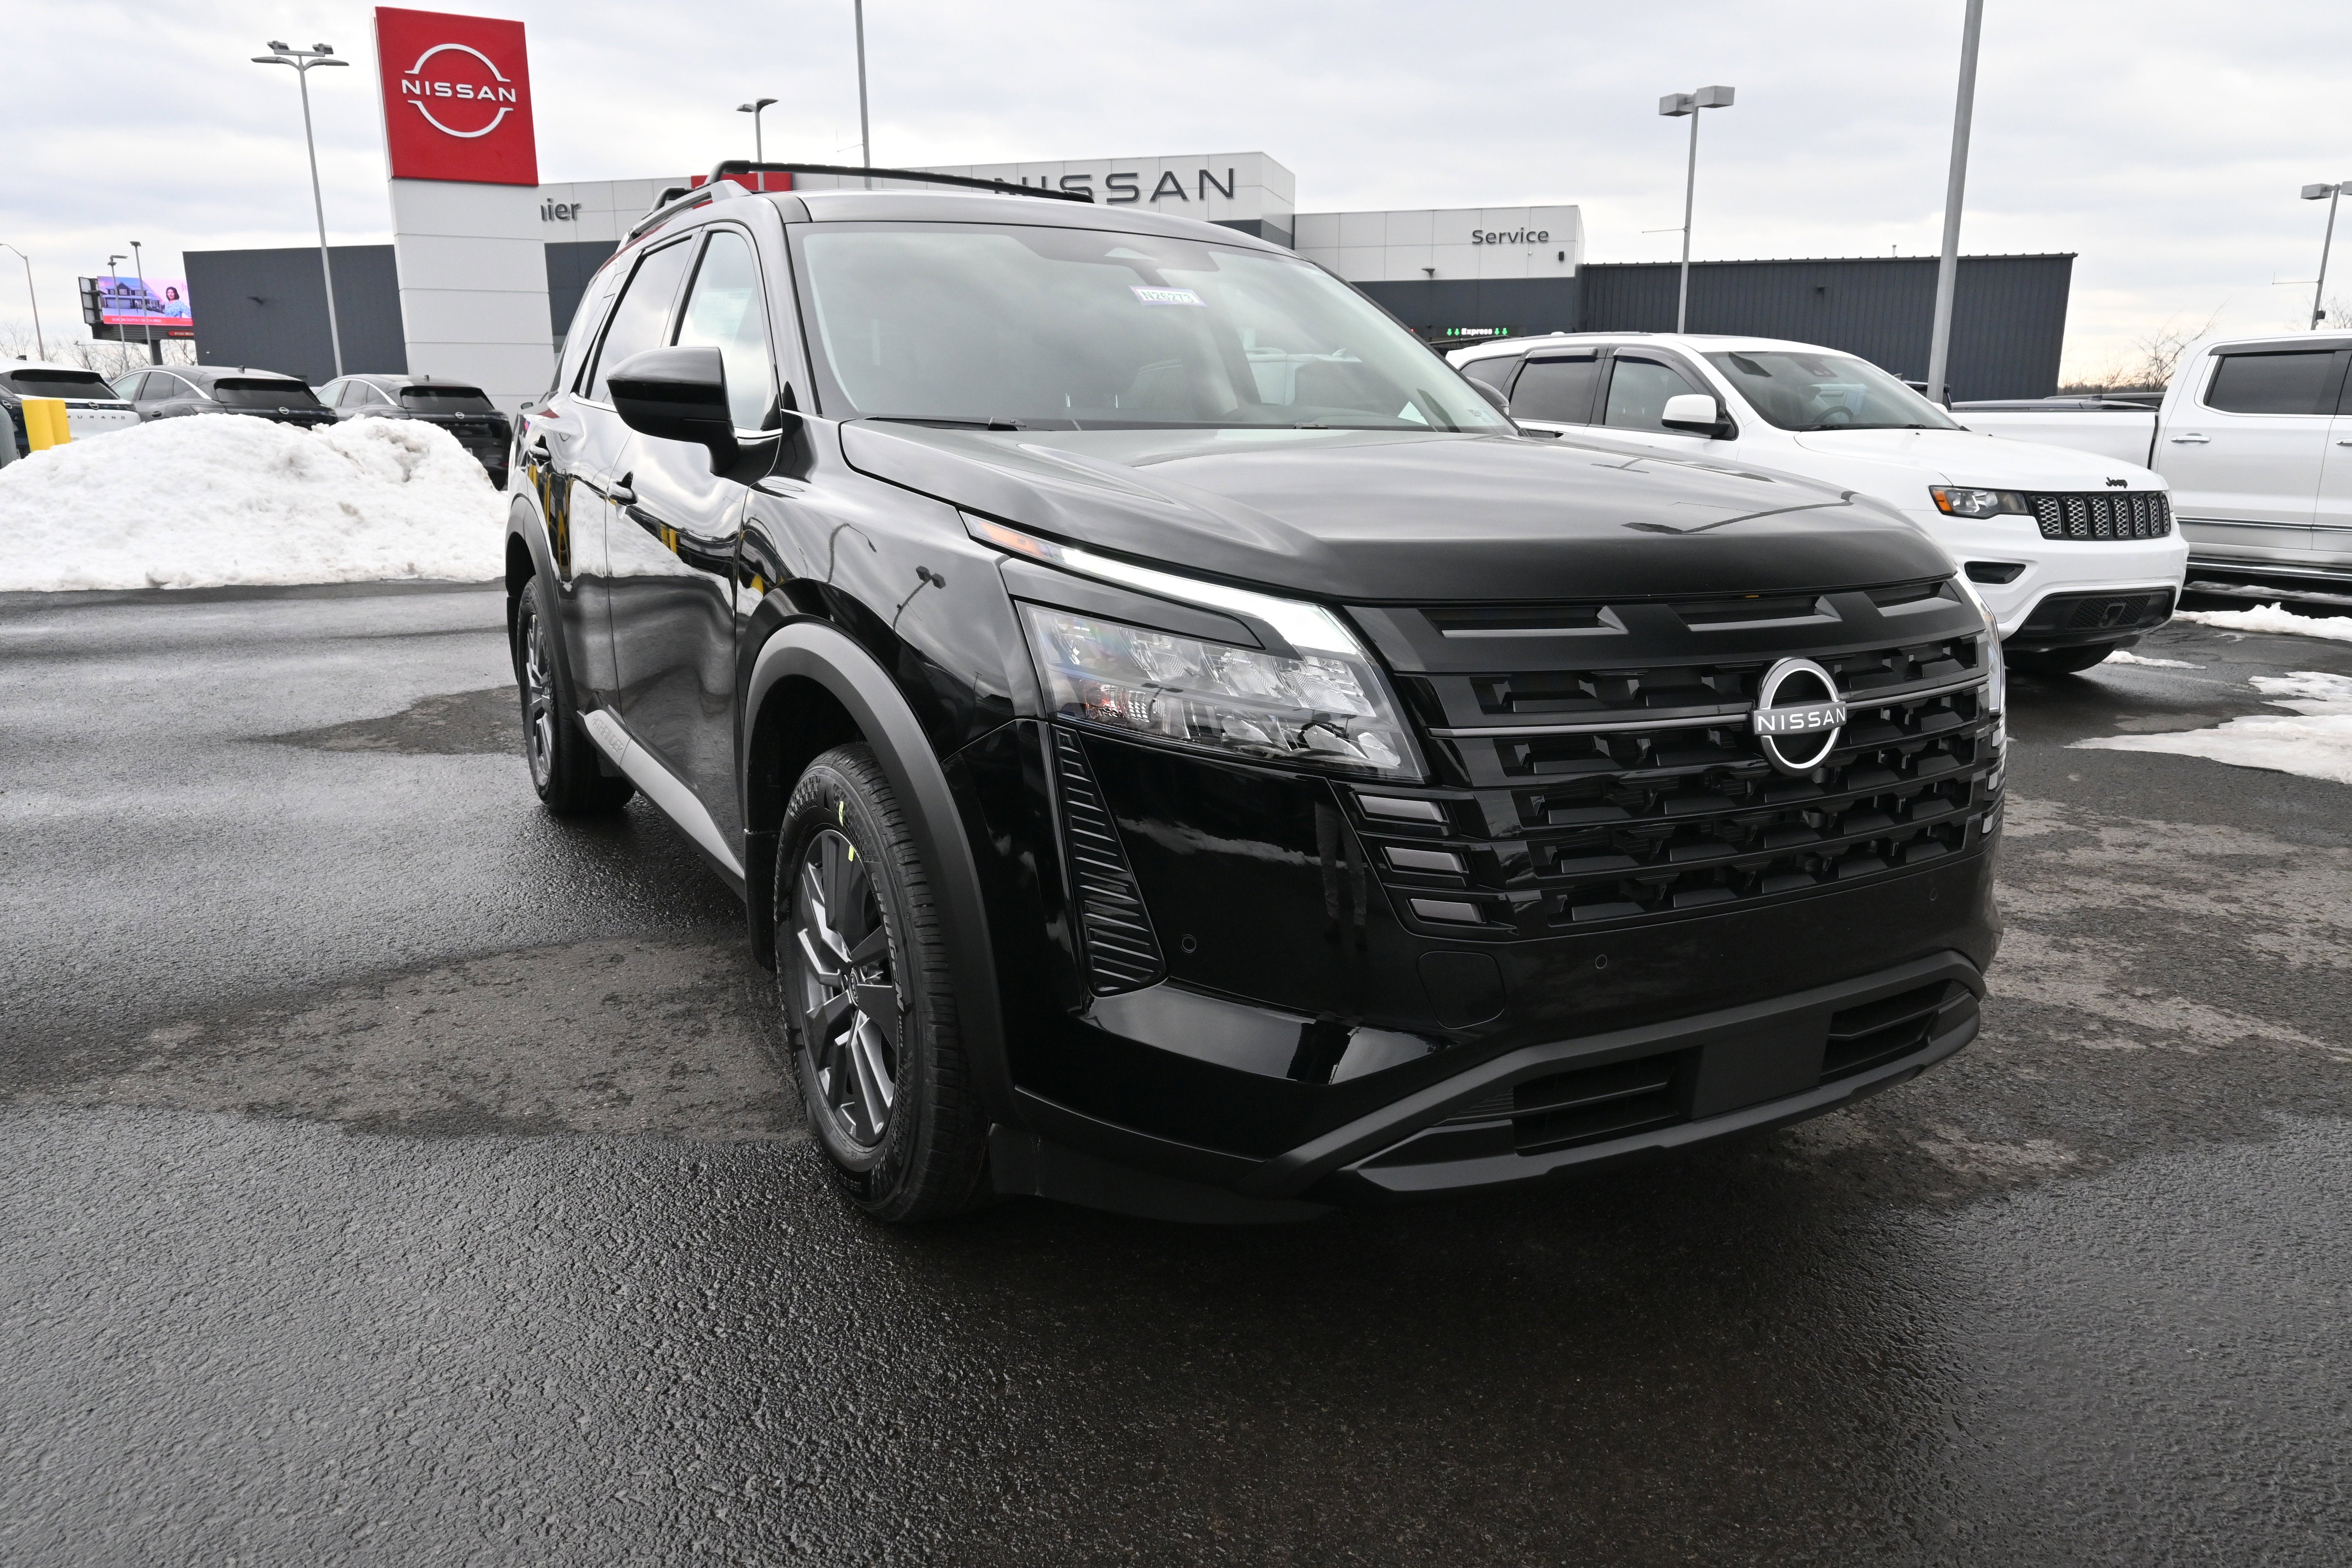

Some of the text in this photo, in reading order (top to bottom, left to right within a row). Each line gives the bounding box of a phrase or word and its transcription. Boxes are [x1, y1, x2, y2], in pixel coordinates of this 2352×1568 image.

[402, 79, 516, 102] NISSAN
[1472, 227, 1549, 245] Service
[1141, 291, 1195, 303] N26273
[1461, 328, 1492, 336] Express
[2105, 477, 2128, 489] Jeep
[1758, 706, 1846, 731] NISSAN
[591, 714, 624, 753] PATHFINDER
[871, 871, 904, 1013] CRUGEN
